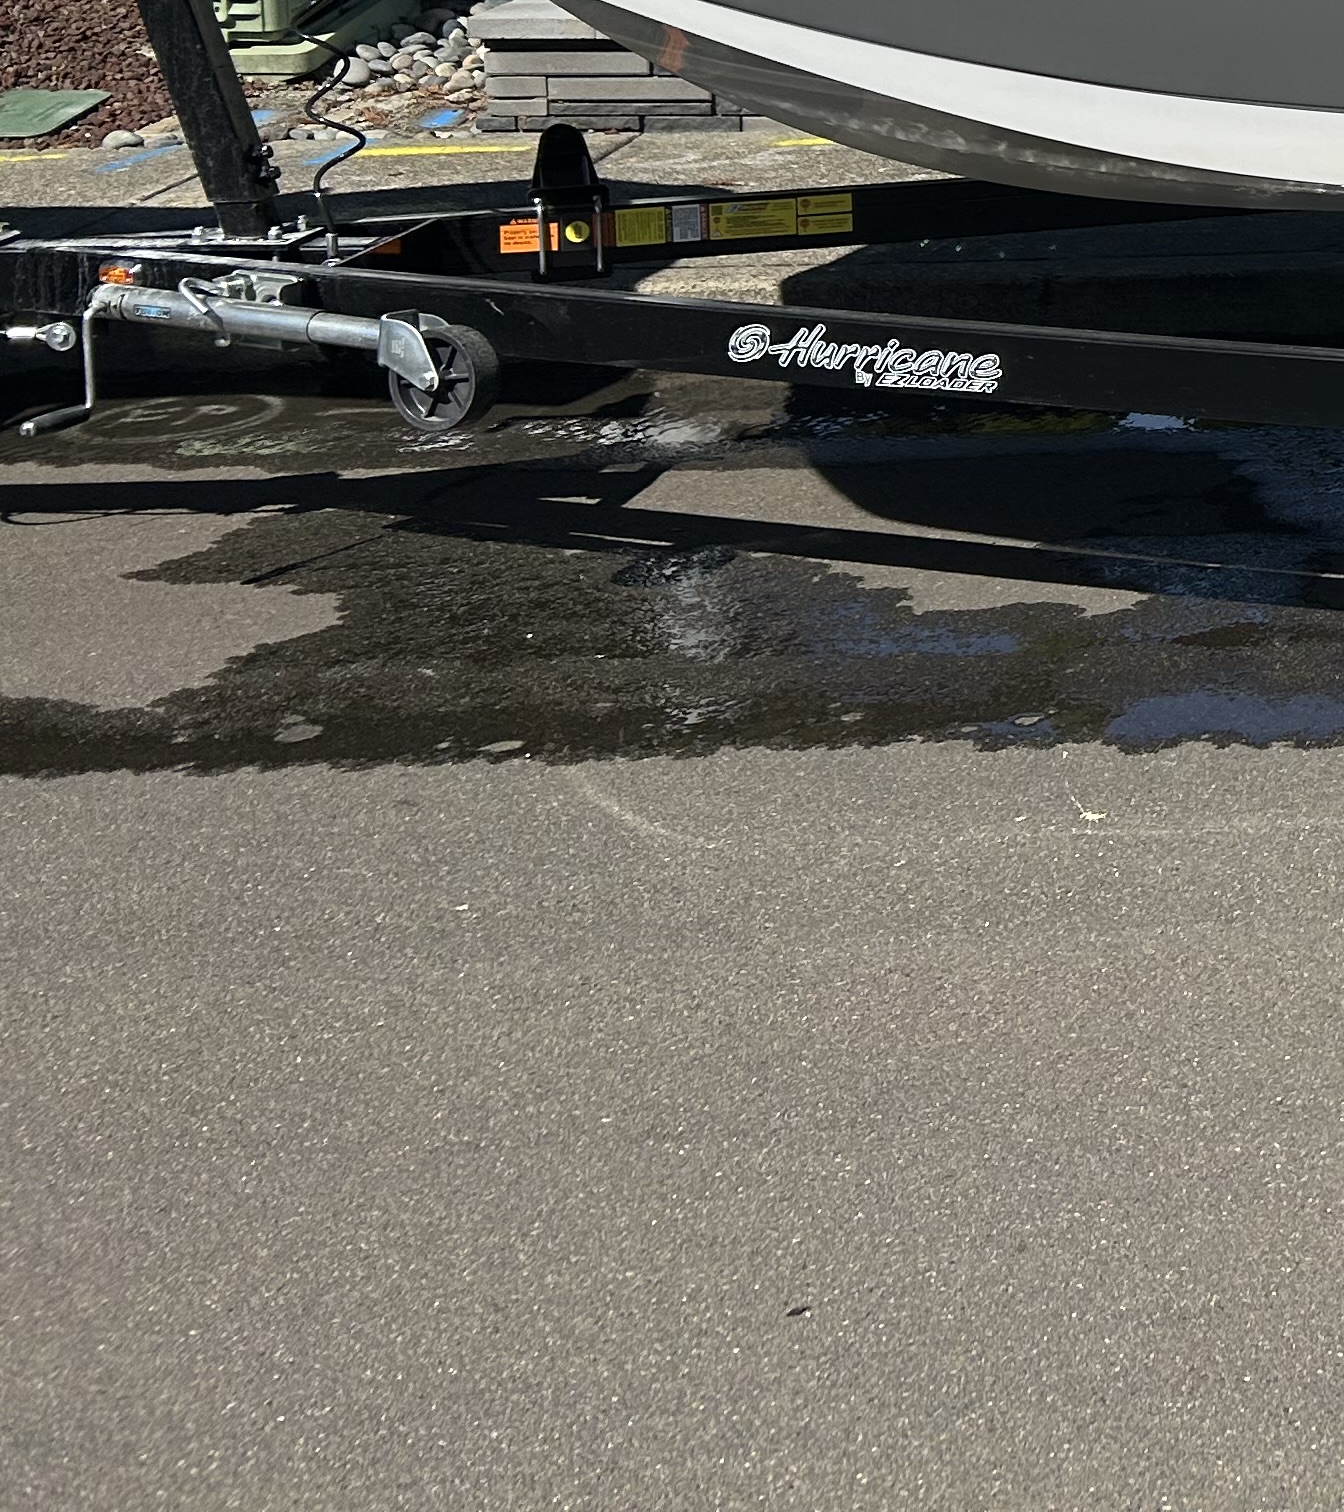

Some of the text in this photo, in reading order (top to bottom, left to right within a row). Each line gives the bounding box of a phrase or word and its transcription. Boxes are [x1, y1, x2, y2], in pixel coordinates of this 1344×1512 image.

[768, 324, 1002, 380] Hurricane
[855, 370, 1000, 394] By EZLOADER
